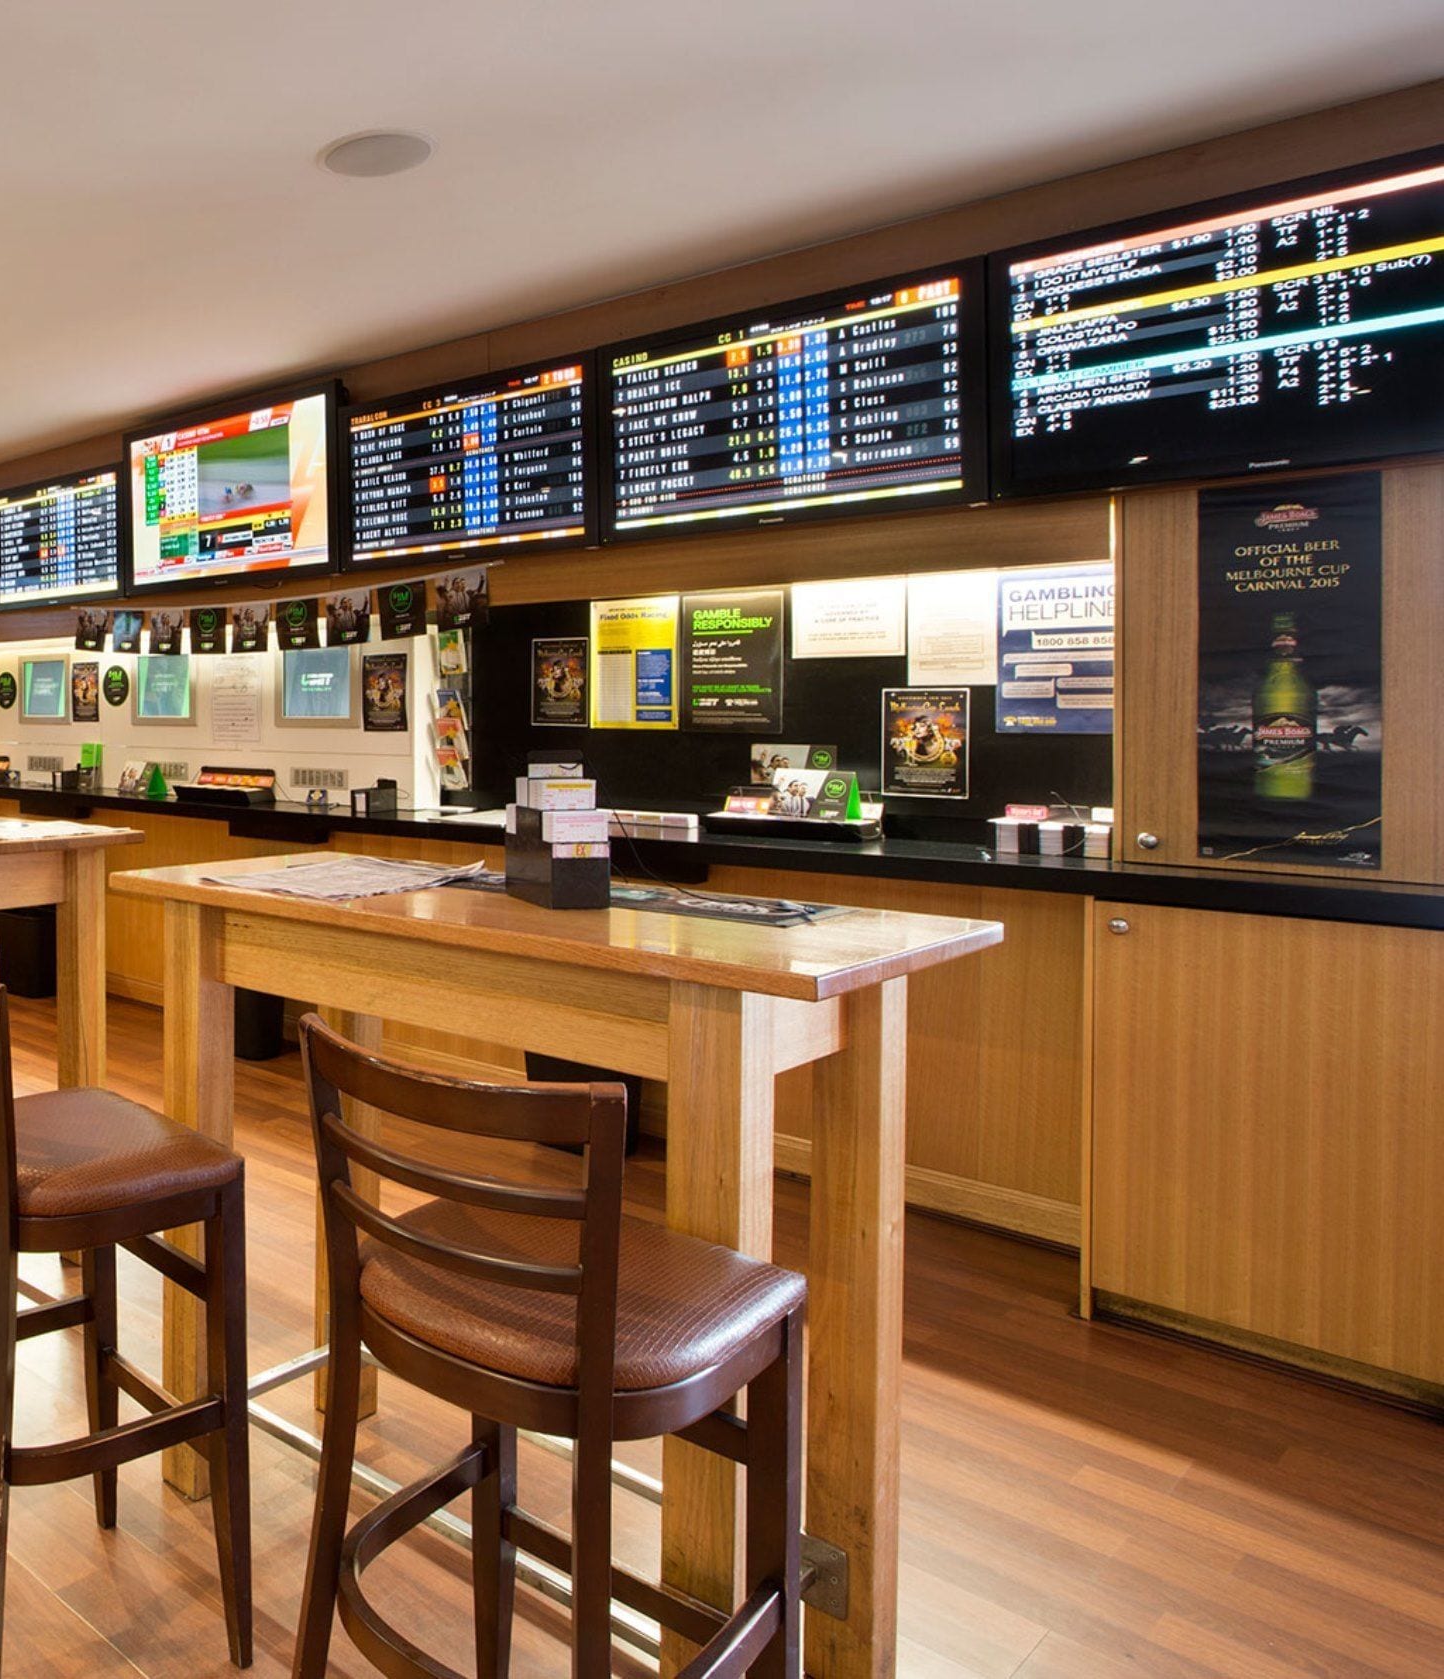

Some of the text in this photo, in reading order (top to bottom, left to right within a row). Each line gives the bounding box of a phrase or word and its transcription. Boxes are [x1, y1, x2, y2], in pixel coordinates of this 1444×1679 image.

[1271, 204, 1338, 227] SCR NIL
[1276, 224, 1298, 237] TF
[1276, 235, 1297, 248] A2
[1034, 261, 1081, 279] GRACE
[1086, 243, 1161, 268] SEELSTER
[1224, 222, 1256, 237] 1.40
[1019, 233, 1257, 292] 1 I DO IT MYSELF 1.00
[1017, 292, 1025, 302] 2
[1118, 263, 1161, 281] ROSA
[1224, 244, 1257, 259] 4.10
[1272, 277, 1308, 292] SCR
[1312, 274, 1323, 284] 3
[1352, 265, 1371, 277] 10
[1375, 253, 1431, 273] Sub(7)
[1013, 254, 1257, 313] QN $2.10
[1013, 265, 1257, 321] EX $3.00
[1277, 290, 1299, 302] TF
[1277, 301, 1298, 313] A2
[1036, 322, 1073, 337] JINJA
[1076, 314, 1118, 330] JAFFA
[1020, 320, 1137, 349] 1 GOLDSTAR PO
[1087, 332, 1127, 347] ZARA
[1014, 330, 1257, 379] EX $23.10
[1273, 343, 1309, 357] SCR
[613, 352, 648, 368] CASINO
[1014, 358, 1035, 370] QN
[1278, 355, 1301, 367] TF
[1278, 366, 1299, 378] F4
[1019, 369, 1150, 398] 4 MING MEN SHEN
[1037, 389, 1090, 405] ARCADIA
[1092, 380, 1150, 396] DYNASTY
[1227, 362, 1258, 375] 1.20
[1277, 377, 1299, 389] A2
[1019, 373, 1258, 417] 2 CLASSY ARROW 1.30
[1015, 384, 1258, 427] QN $11.30
[628, 431, 665, 447] STEVE'S
[1015, 427, 1034, 437] EX
[1235, 540, 1340, 557] OFFICIAL BEER
[1259, 554, 1313, 567] OF THE
[1226, 564, 1350, 581] MELBOURNE CUP
[1235, 577, 1340, 592] CARNIVAL 2015
[692, 608, 773, 630] GAMBLE RESPONSIBLY
[1037, 638, 1063, 646] 1800
